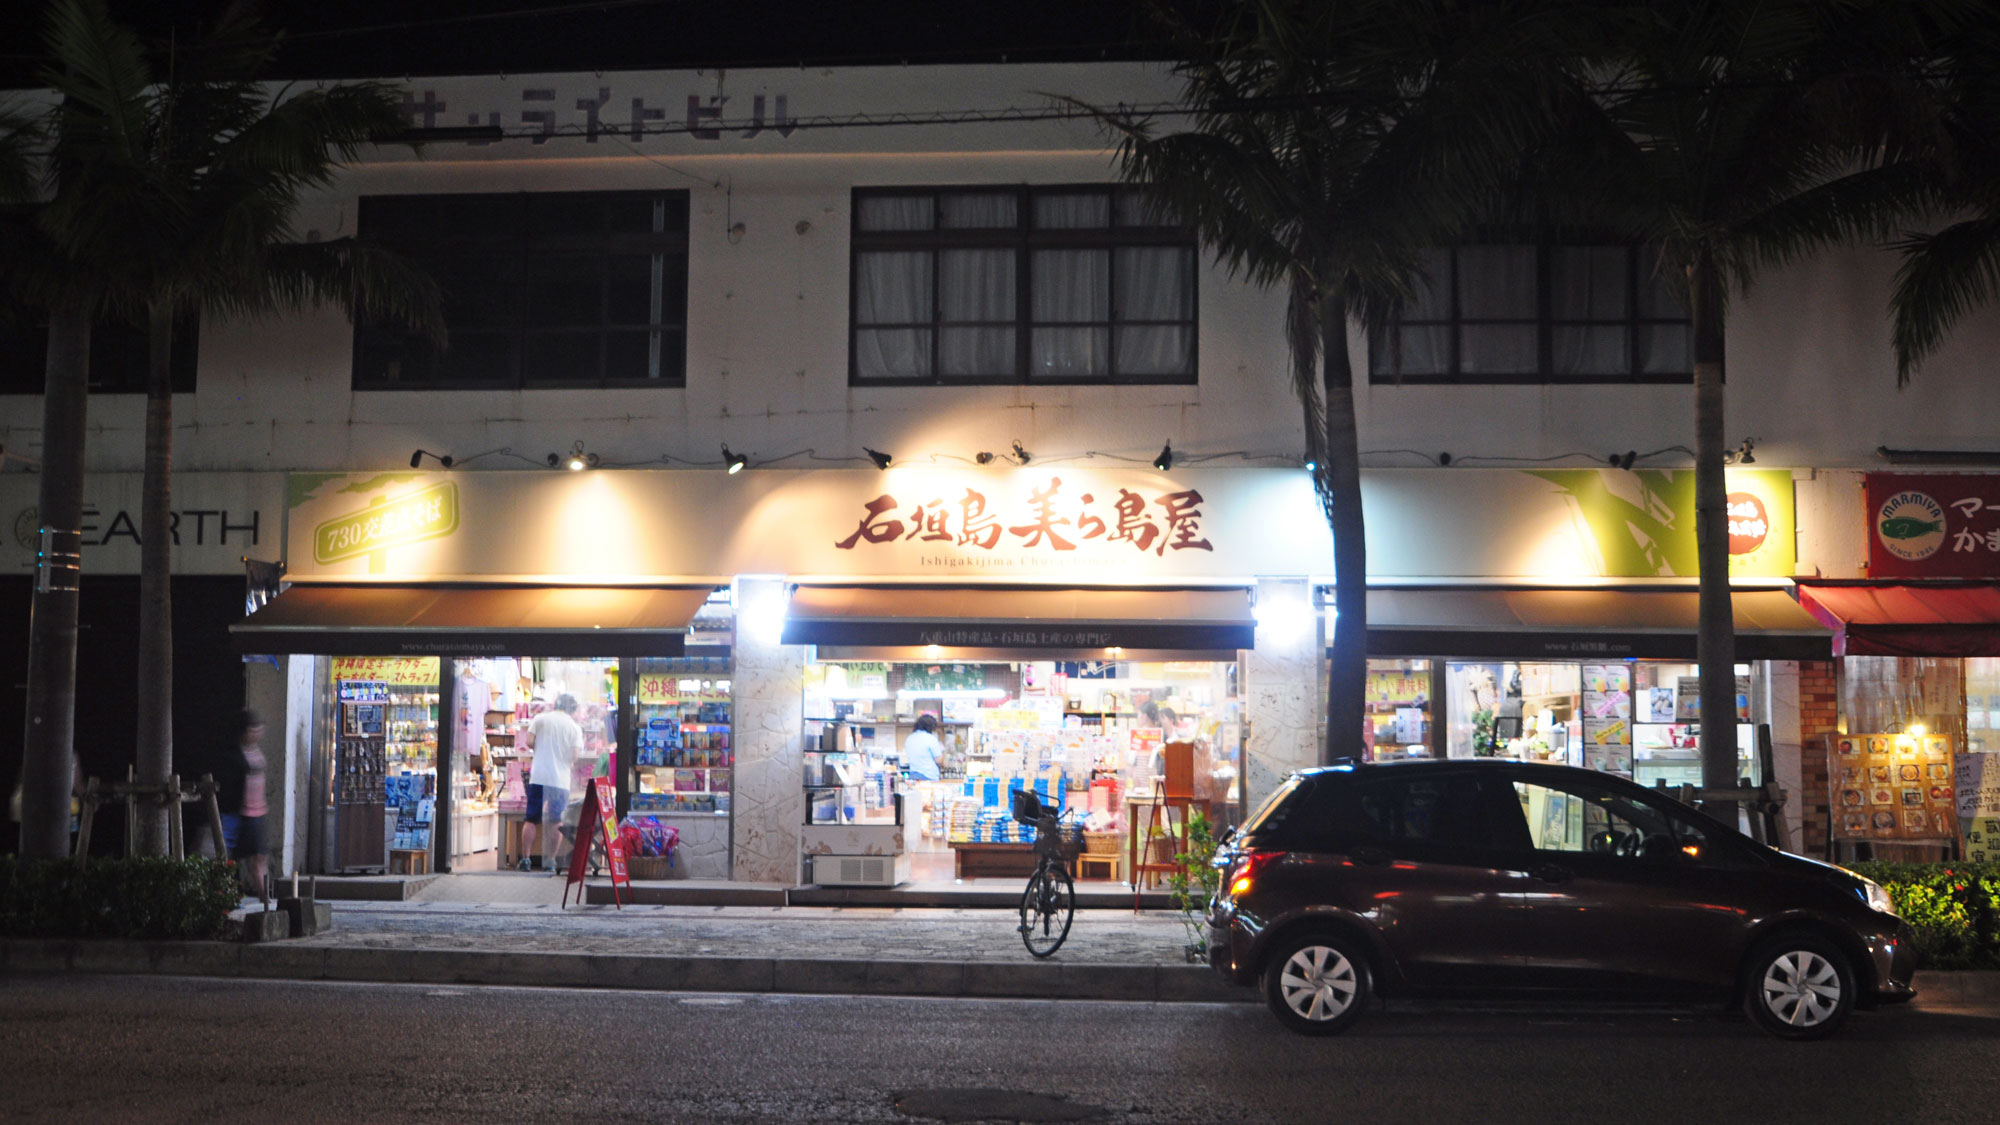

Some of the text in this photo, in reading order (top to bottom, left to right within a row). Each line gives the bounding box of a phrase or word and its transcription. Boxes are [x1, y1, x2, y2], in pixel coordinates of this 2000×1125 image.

[1882, 493, 1942, 519] MARMIYA
[835, 476, 1213, 558] 石垣島美ら島屋
[1889, 543, 1913, 558] SINCE
[920, 556, 1013, 568] Ishigakijima
